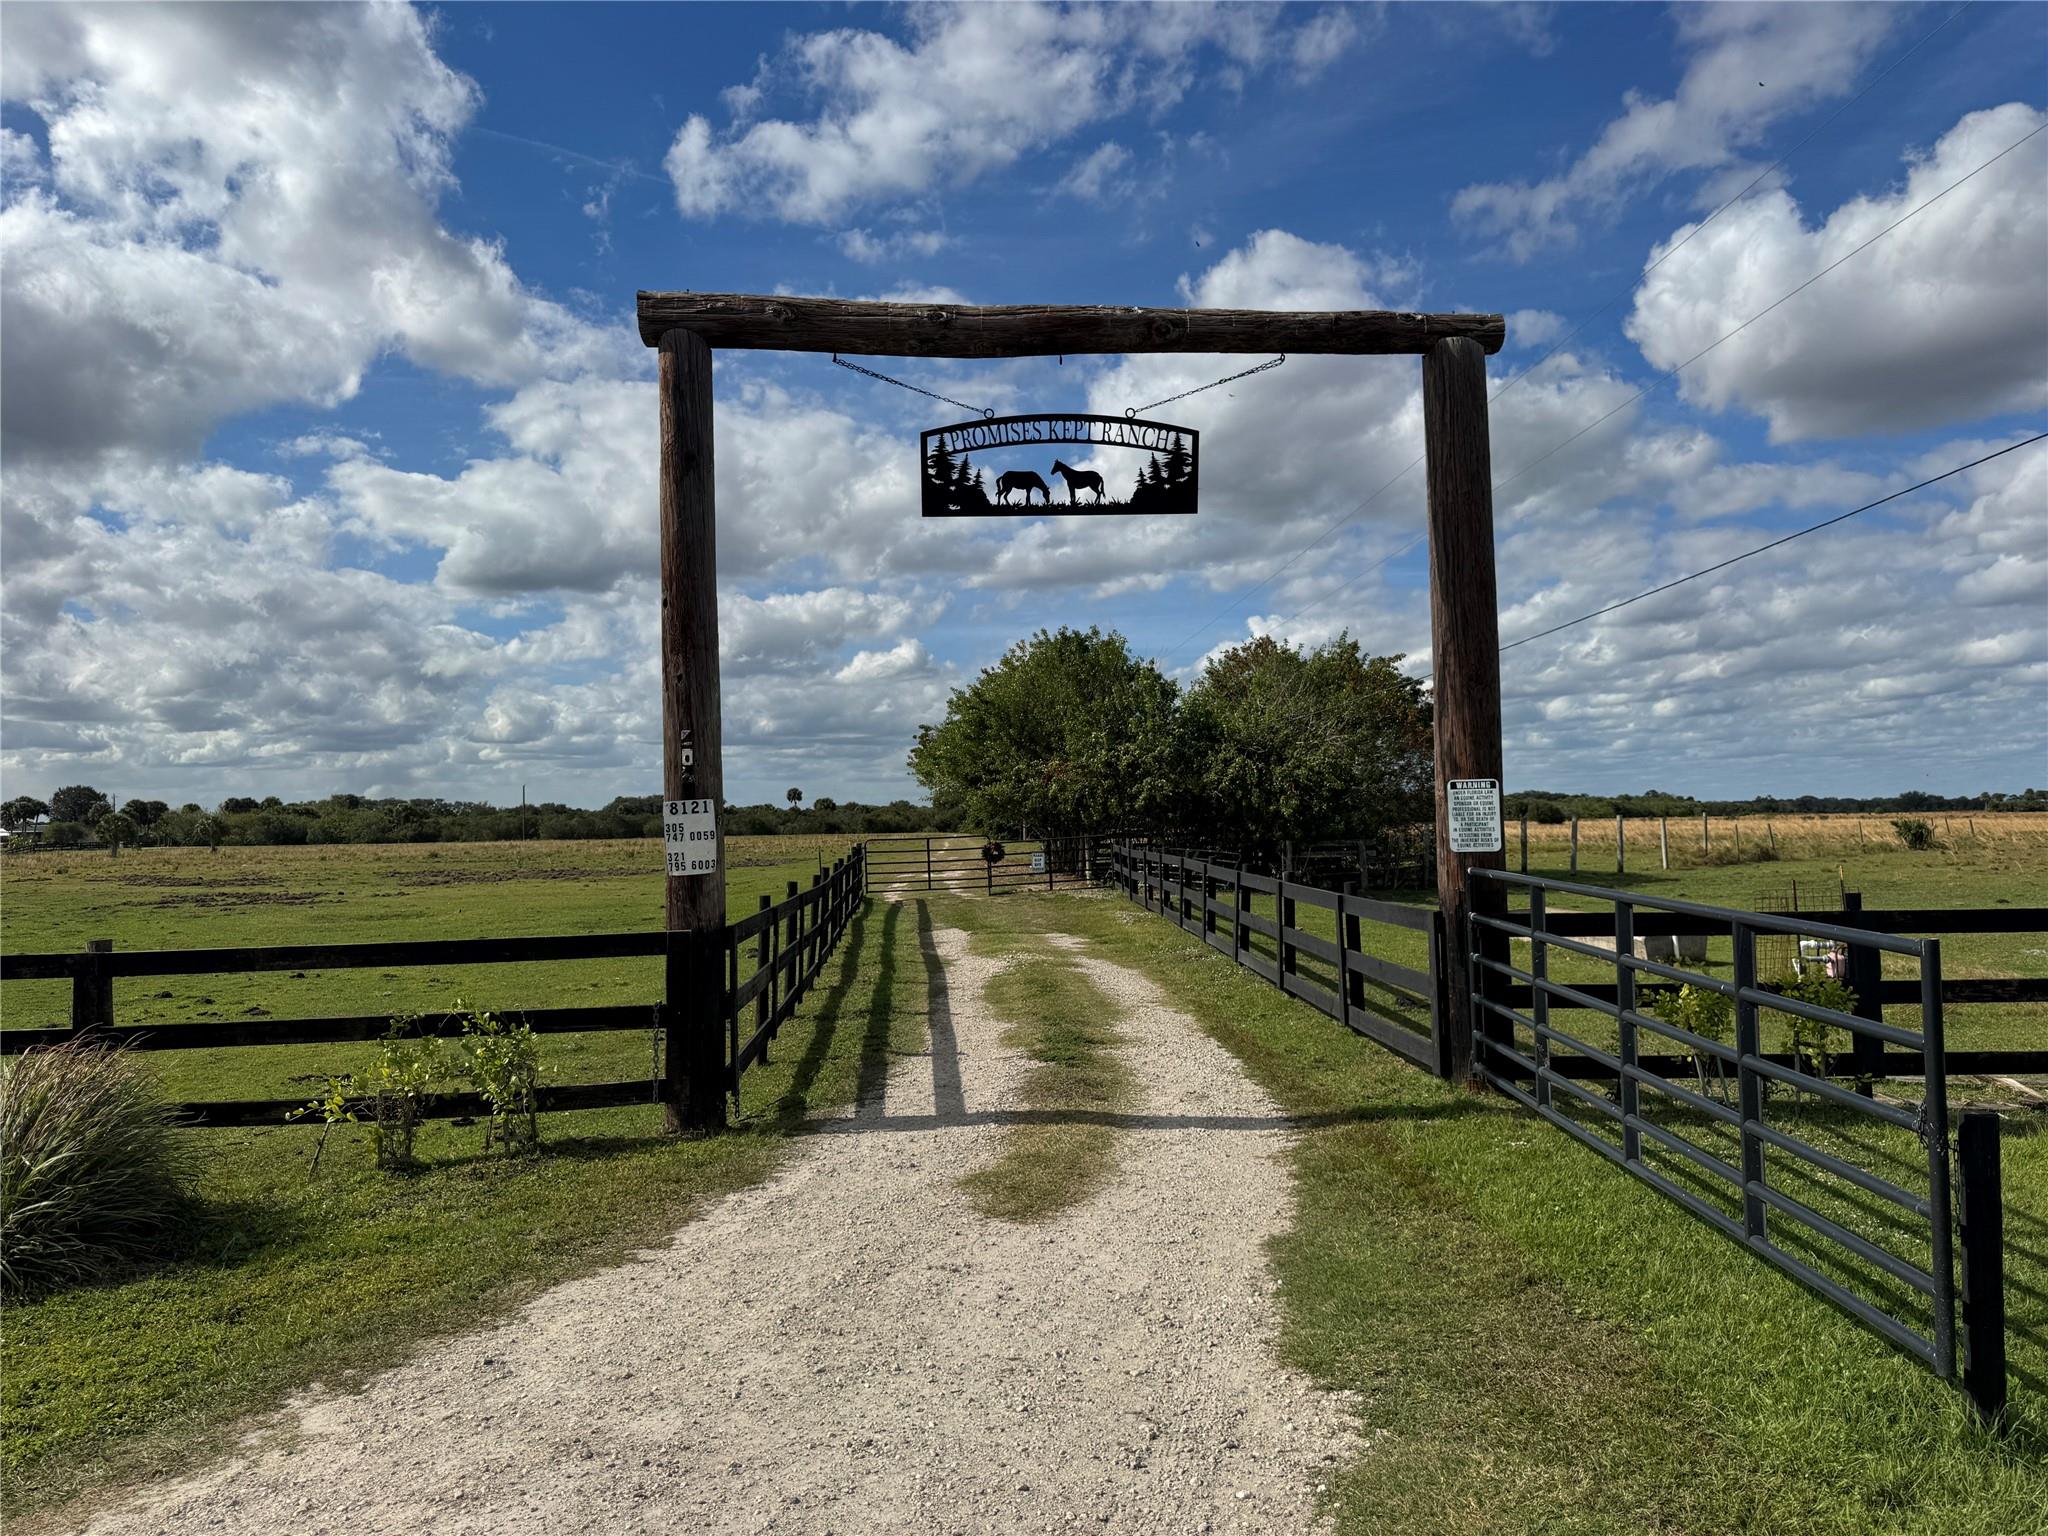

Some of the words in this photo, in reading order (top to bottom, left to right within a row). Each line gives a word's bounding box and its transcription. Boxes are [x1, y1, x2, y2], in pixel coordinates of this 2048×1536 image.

[950, 421, 1041, 451] PROMISES
[1049, 420, 1097, 440] KEPT
[1102, 422, 1170, 449] RANCH
[670, 800, 709, 815] 8121
[665, 823, 684, 833] 305
[666, 833, 684, 842] 747
[690, 831, 715, 841] 0059
[668, 853, 684, 861] 321
[669, 862, 686, 871] 795
[691, 860, 716, 870] 6003
